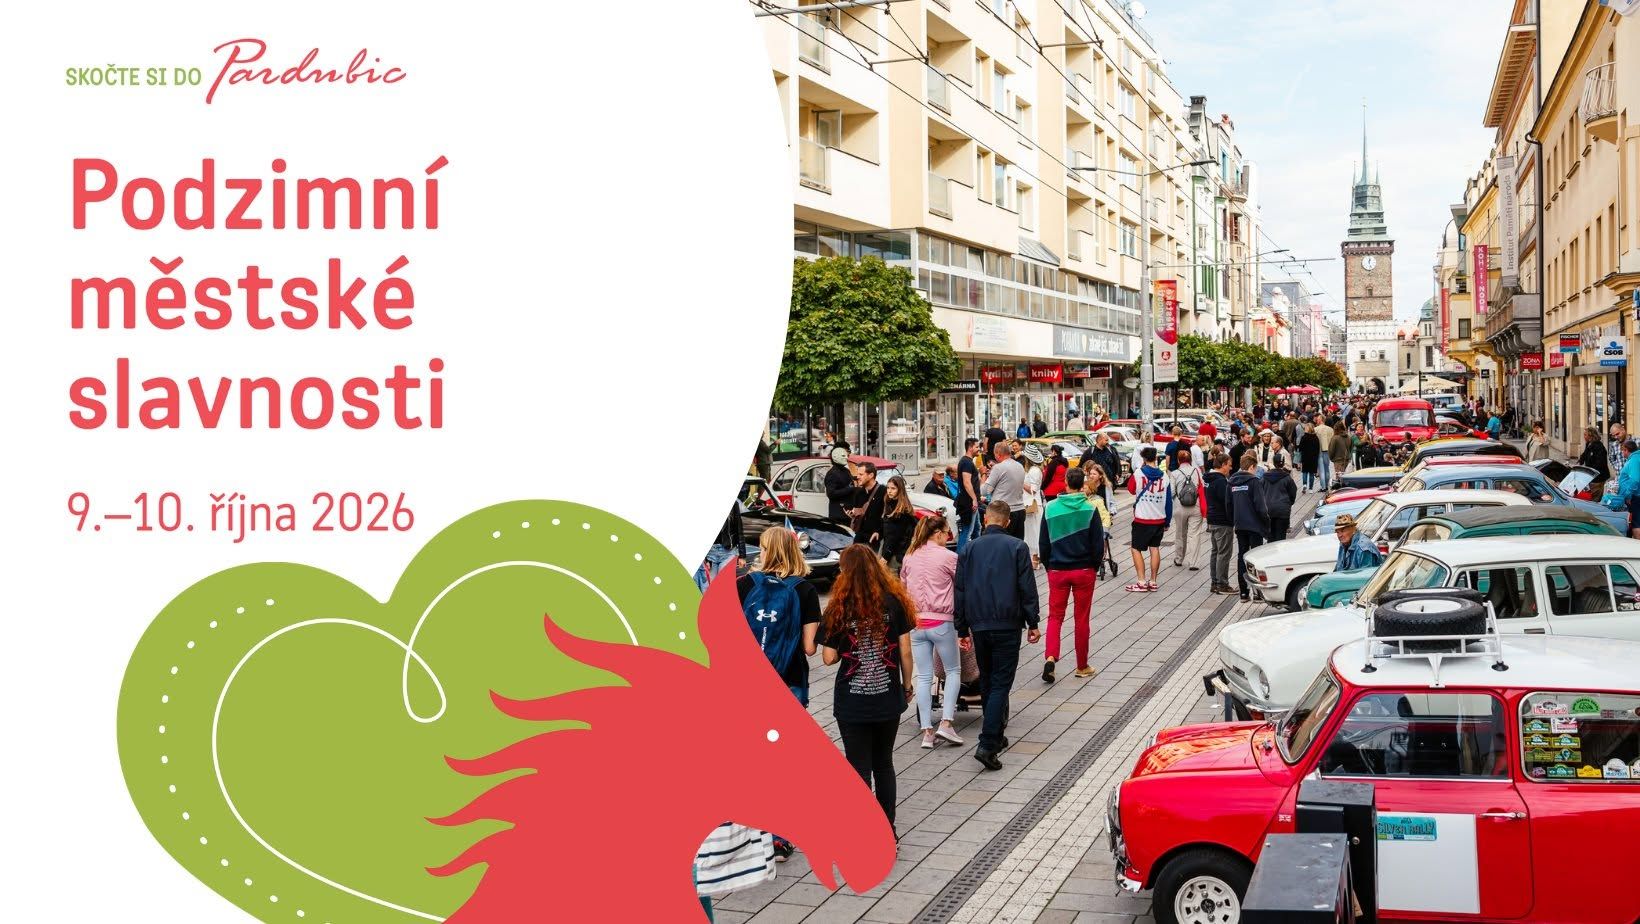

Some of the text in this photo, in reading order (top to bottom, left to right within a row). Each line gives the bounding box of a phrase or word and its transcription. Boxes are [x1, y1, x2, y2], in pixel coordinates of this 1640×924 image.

[1504, 175, 1514, 271] Institut Paměti národa
[1603, 348, 1624, 356] ČSOB
[1031, 368, 1059, 379] knihy
[1141, 476, 1165, 493] NFL
